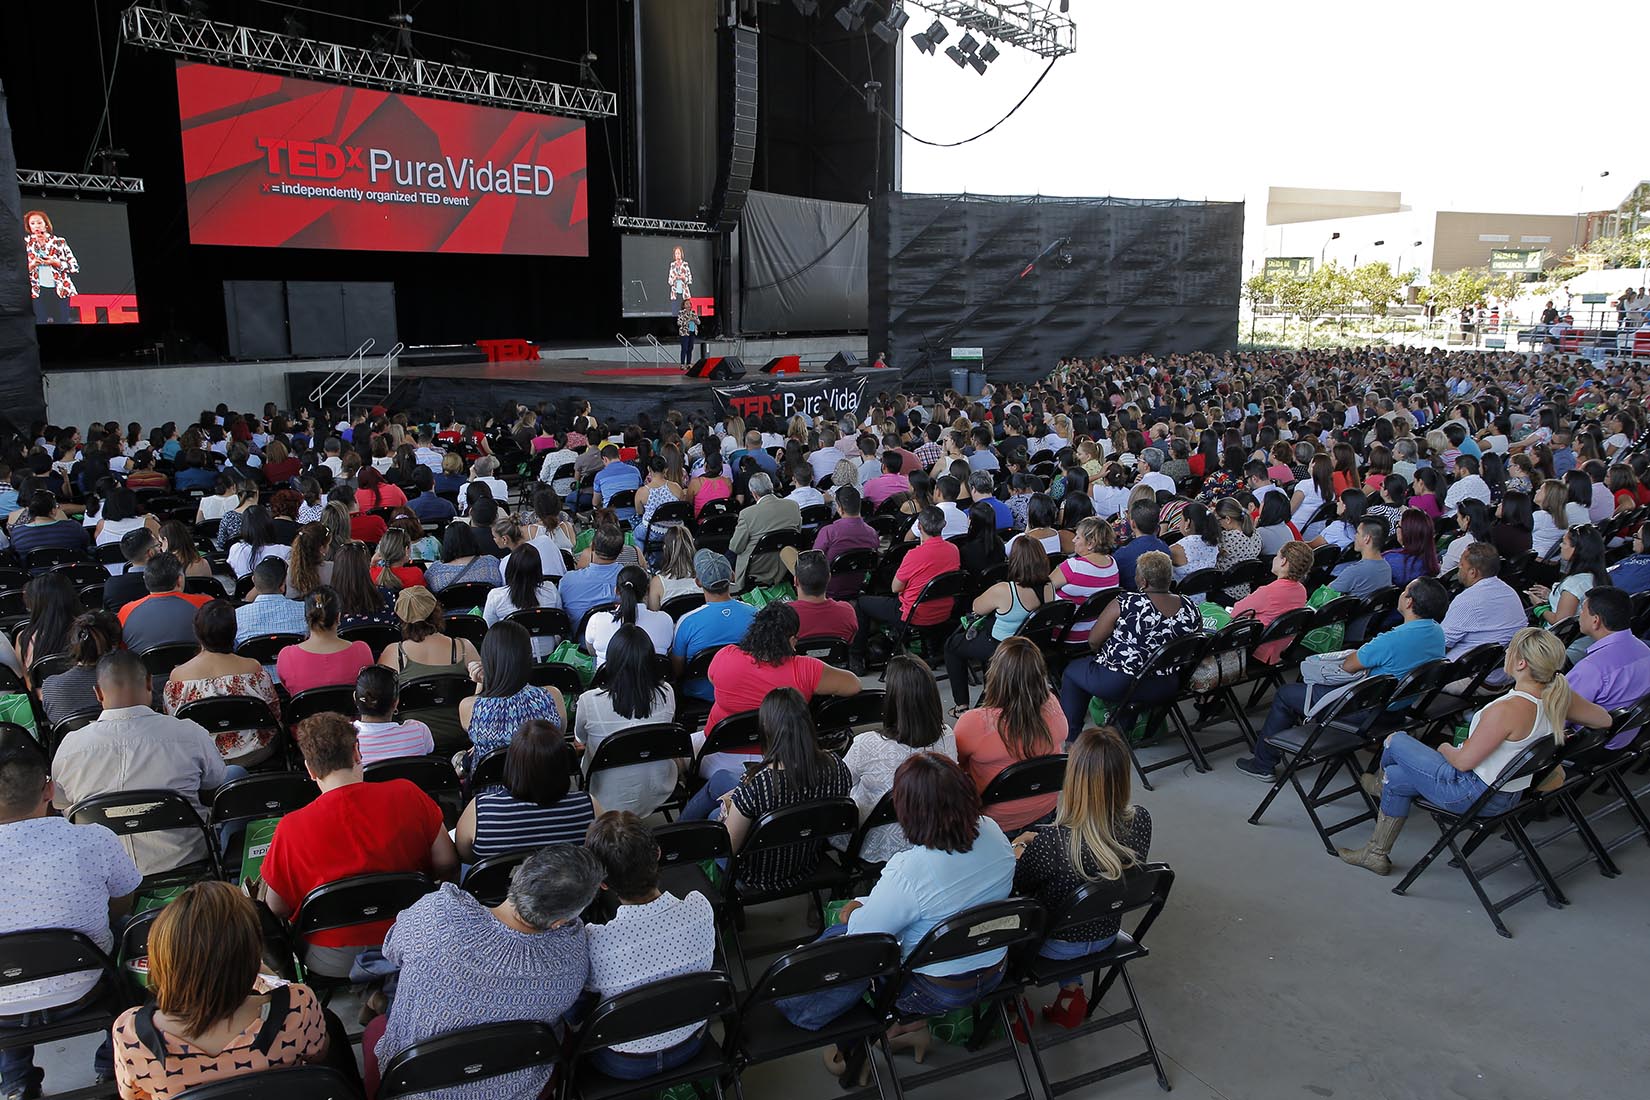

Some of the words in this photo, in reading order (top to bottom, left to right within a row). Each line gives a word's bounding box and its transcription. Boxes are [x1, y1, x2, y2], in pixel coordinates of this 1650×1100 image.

[281, 182, 364, 200] independently
[366, 190, 417, 203] organized
[420, 192, 441, 204] TED
[443, 196, 469, 206] event
[823, 387, 858, 411] Vida
